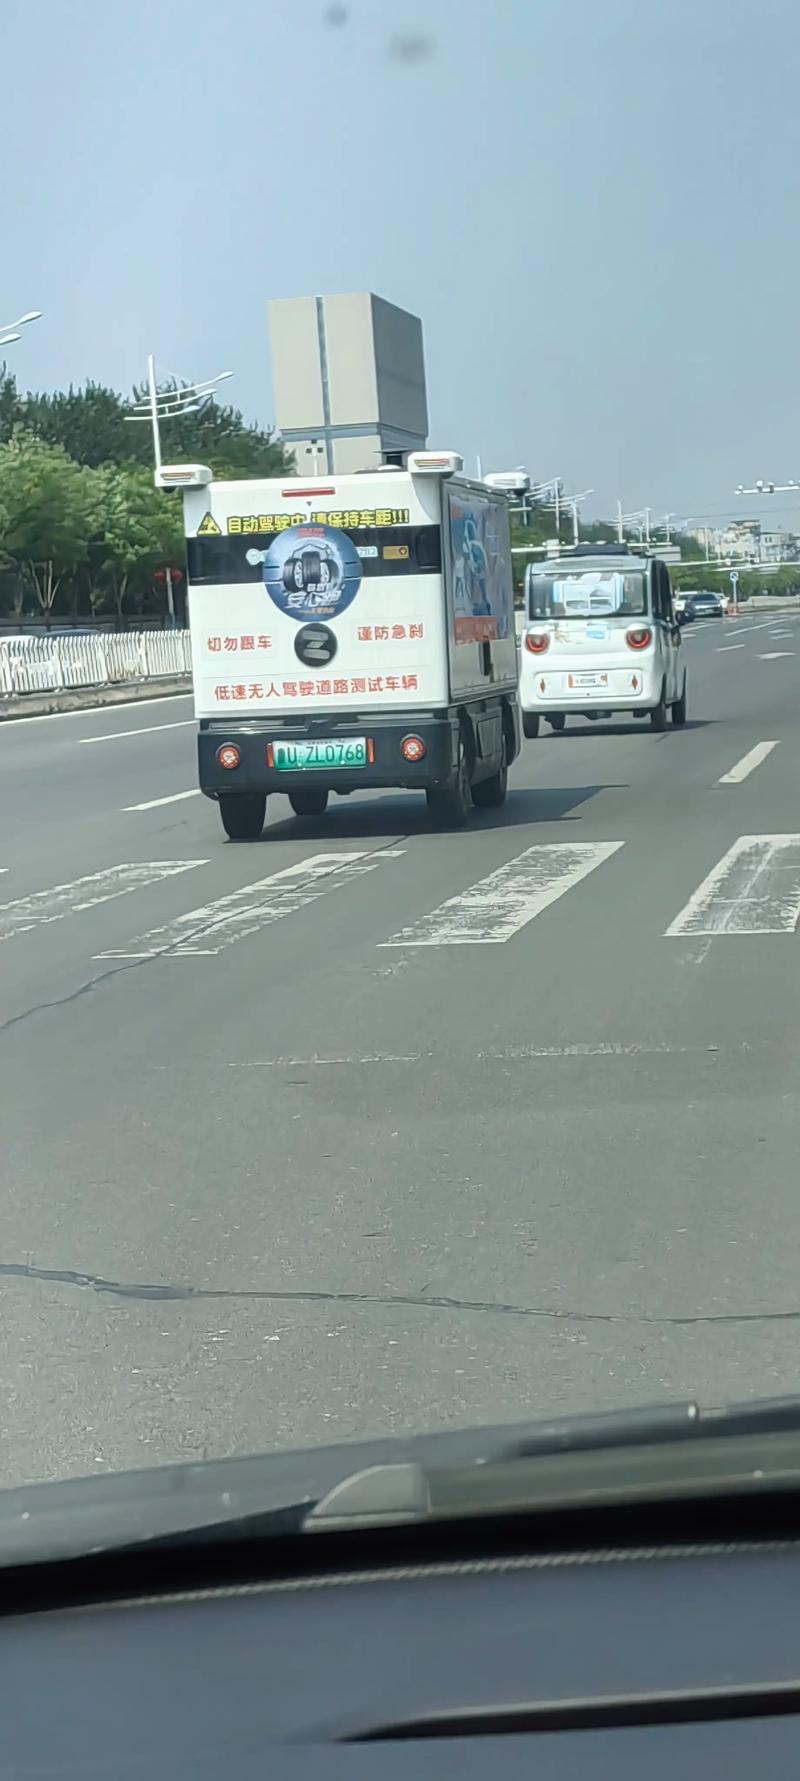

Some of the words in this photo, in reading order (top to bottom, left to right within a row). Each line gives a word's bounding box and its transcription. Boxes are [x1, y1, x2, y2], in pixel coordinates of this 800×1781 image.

[357, 623, 424, 641] 谨防急刹
[207, 635, 272, 652] 切勿跟车
[214, 674, 418, 701] 低速无人驾驶道路测试车辆
